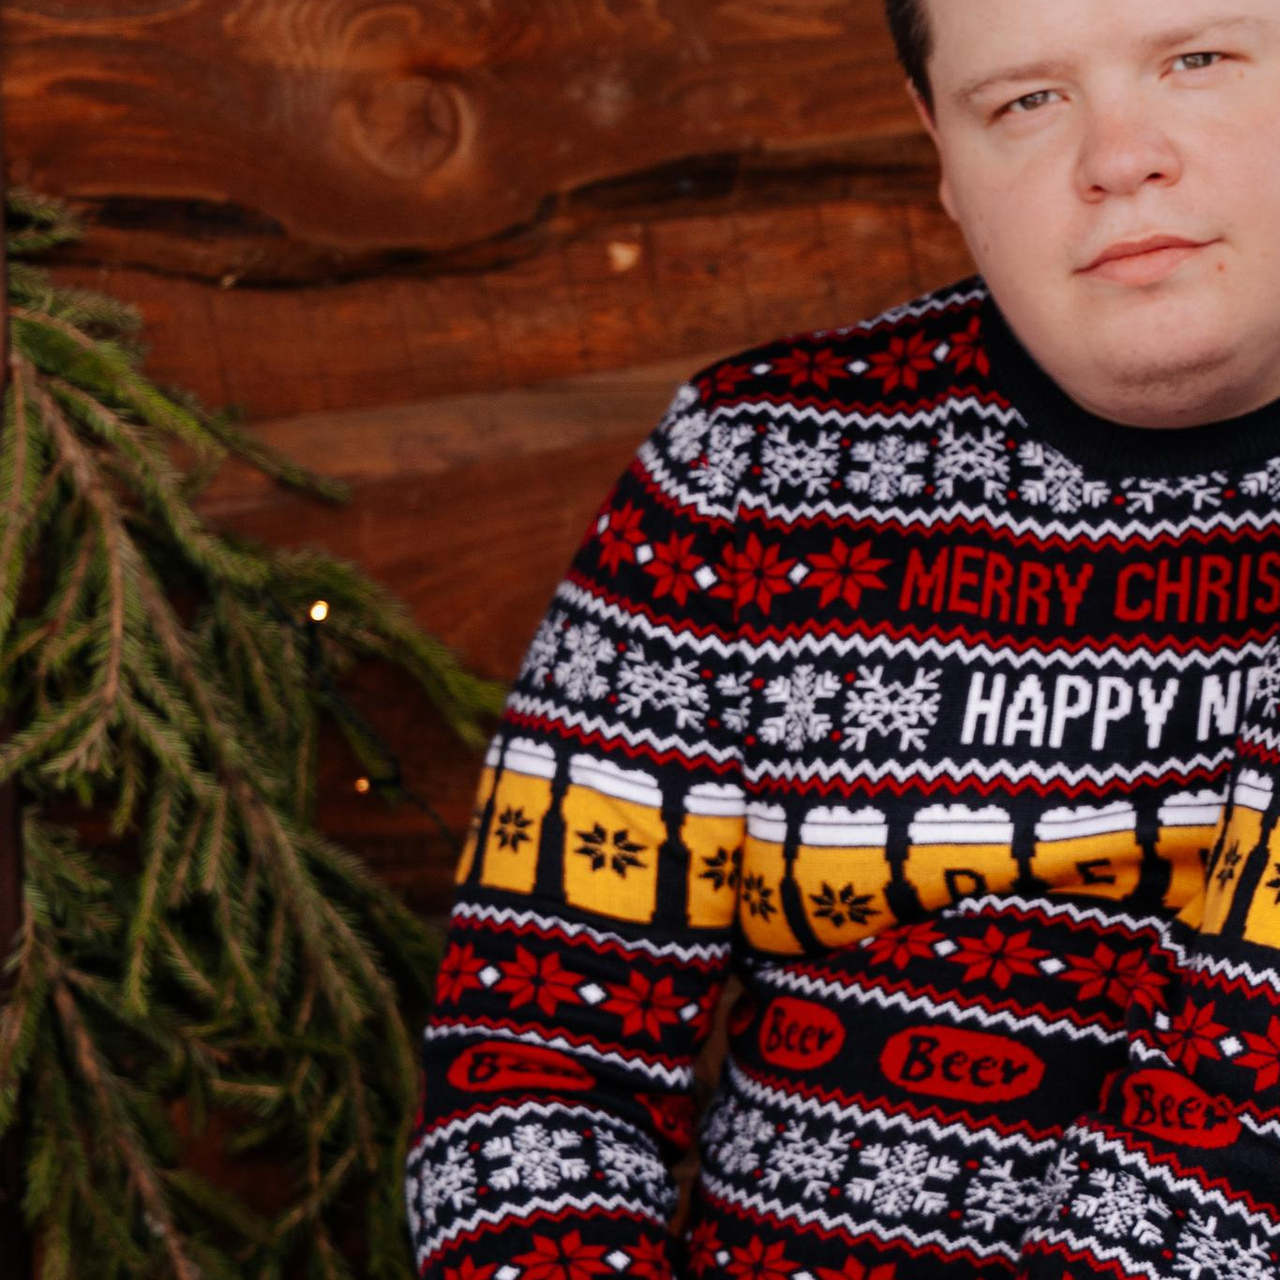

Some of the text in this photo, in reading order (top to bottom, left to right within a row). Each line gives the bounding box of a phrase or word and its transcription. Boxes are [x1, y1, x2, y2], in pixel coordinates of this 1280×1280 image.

[899, 545, 1093, 626] MERRY
[961, 671, 1179, 750] HAPPY
[765, 1006, 835, 1055] Beer
[900, 1034, 1029, 1088] Beer
[1132, 1084, 1228, 1131] Beer
